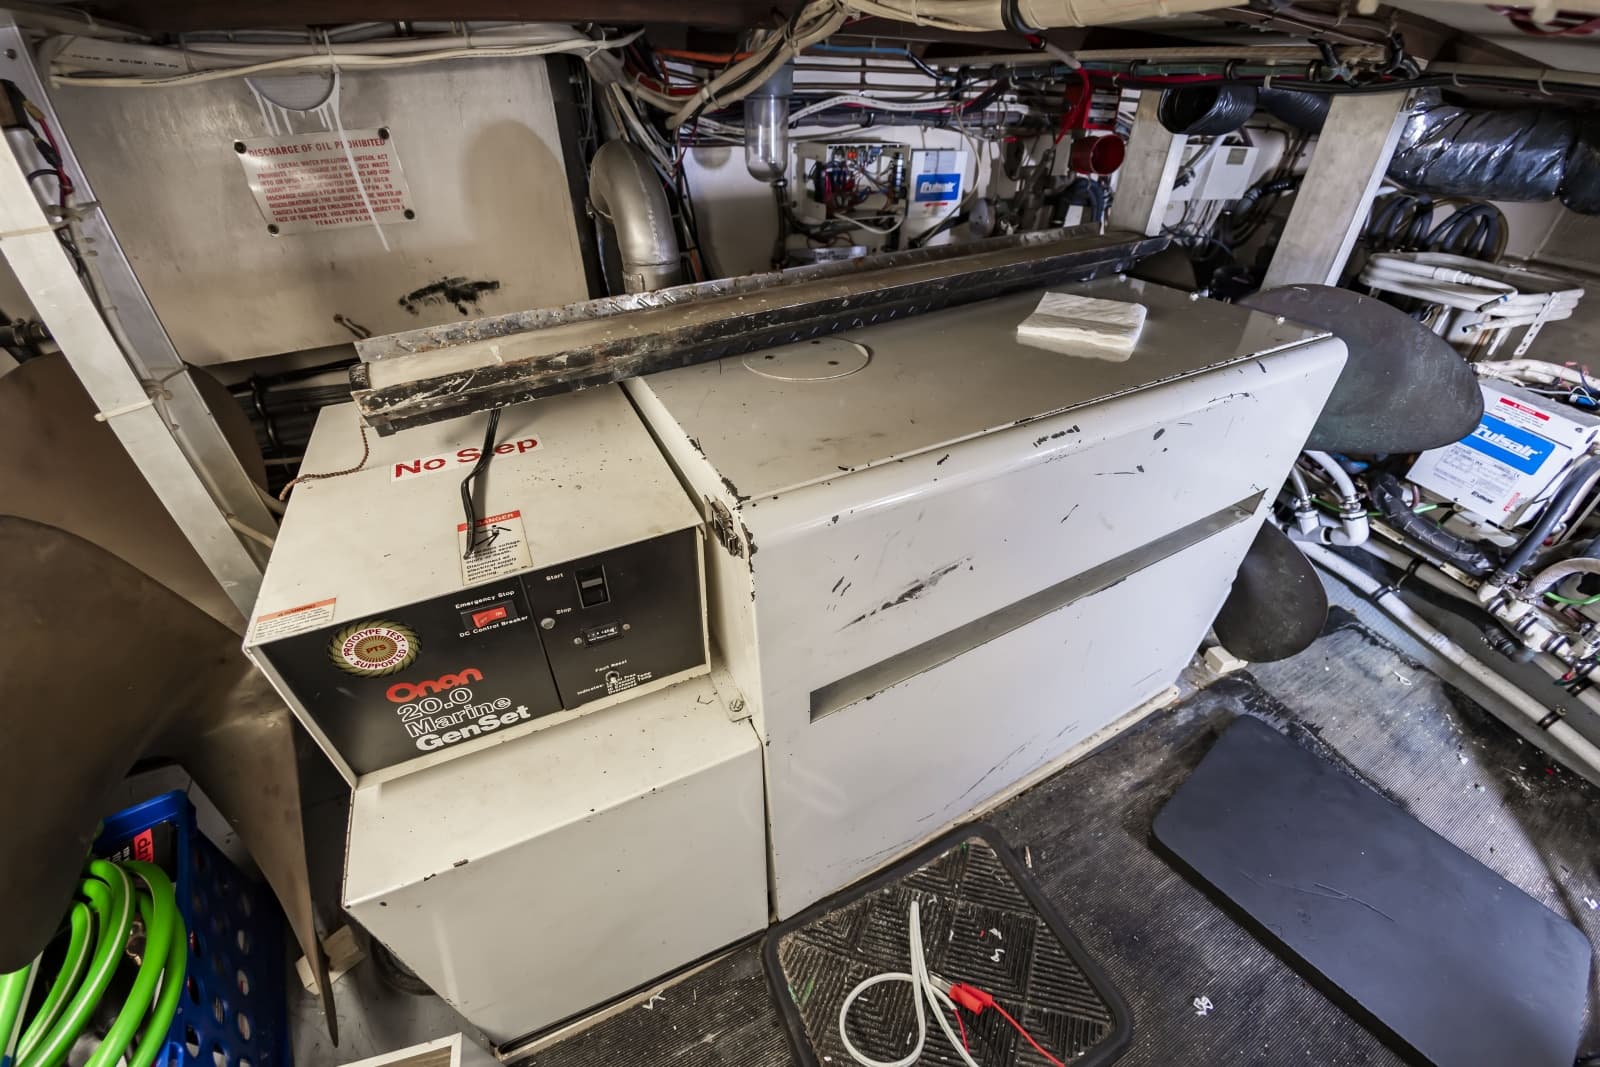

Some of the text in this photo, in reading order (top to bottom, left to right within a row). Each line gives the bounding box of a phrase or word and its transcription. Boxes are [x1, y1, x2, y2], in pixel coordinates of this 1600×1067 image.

[248, 145, 300, 158] DISCHARGE
[300, 143, 313, 153] OF
[314, 142, 332, 152] OIL
[395, 438, 538, 478] No Sep
[480, 513, 514, 524] ANGER
[546, 572, 564, 582] Start
[455, 589, 515, 609] Emergency Stop
[459, 615, 528, 638] DC Control Breaker
[344, 628, 406, 657] PROTOTYPE TEST
[366, 644, 387, 654] PTS
[353, 649, 407, 669] SUPPORTED
[386, 668, 484, 703] Onan
[396, 687, 473, 723] 20.0
[404, 697, 512, 738] Marine
[415, 705, 531, 751] GenSet
